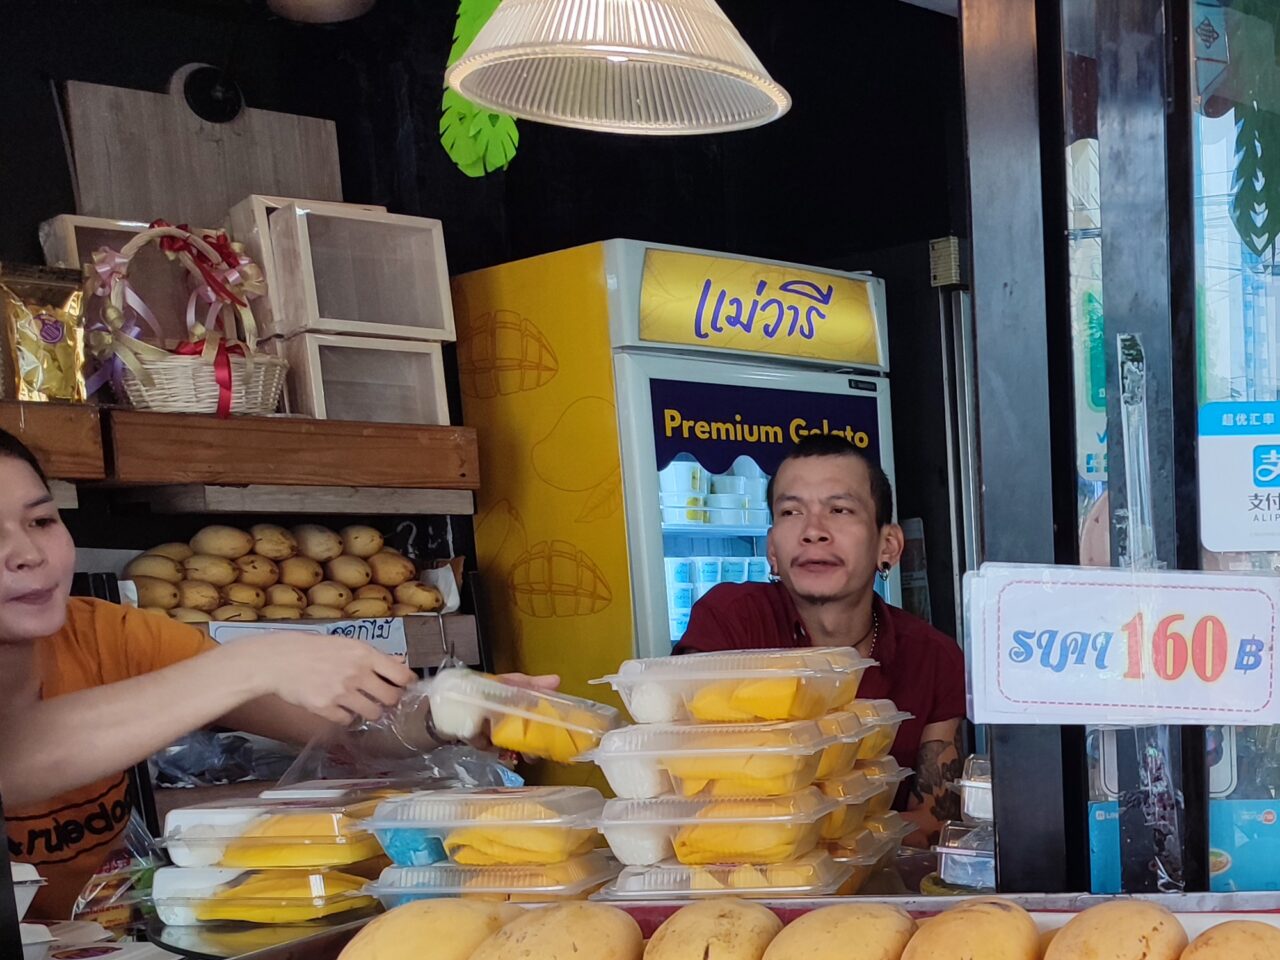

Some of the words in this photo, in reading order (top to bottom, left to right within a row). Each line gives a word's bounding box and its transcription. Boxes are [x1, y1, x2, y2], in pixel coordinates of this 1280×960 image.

[694, 278, 834, 340] แม่วารี
[664, 408, 784, 444] Premium
[1008, 629, 1115, 673] ราคา
[1121, 612, 1229, 683] 160
